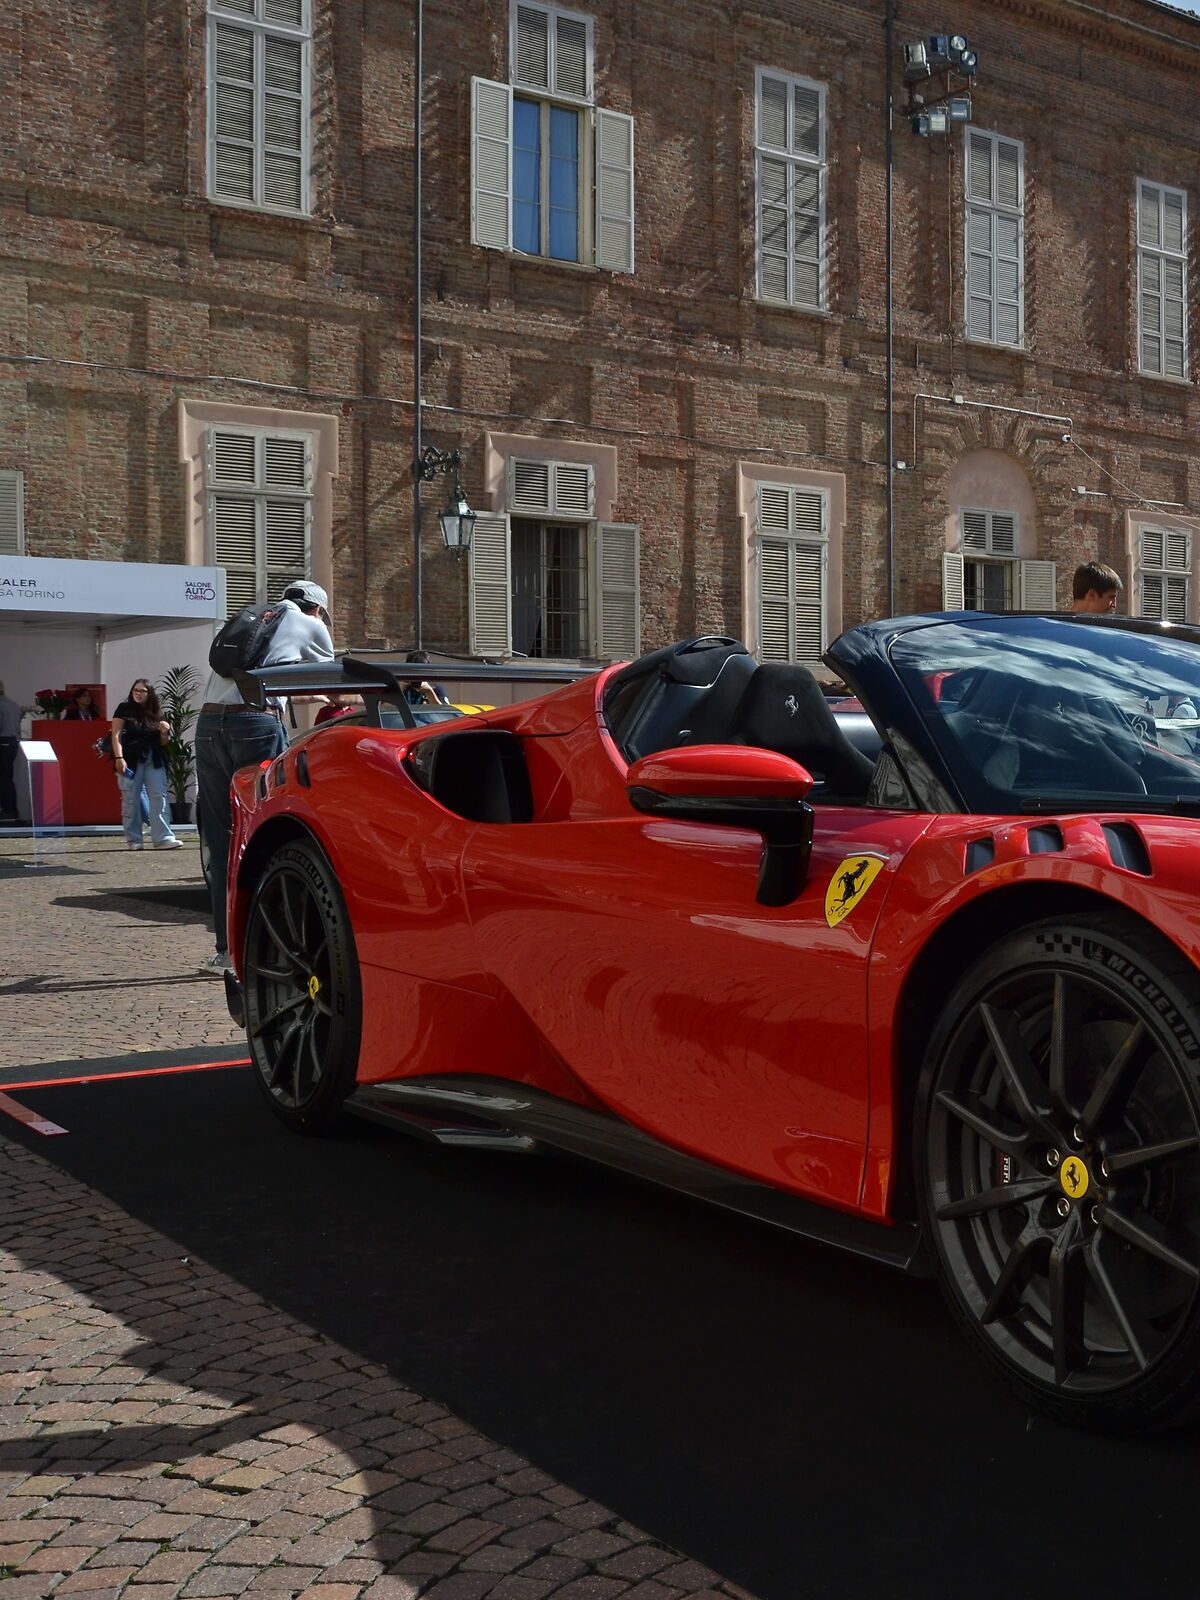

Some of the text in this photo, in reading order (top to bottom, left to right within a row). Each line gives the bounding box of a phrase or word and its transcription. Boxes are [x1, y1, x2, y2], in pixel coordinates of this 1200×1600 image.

[0, 578, 37, 588] ALER
[17, 589, 65, 599] TORINO
[1106, 954, 1200, 1056] MICHELIN
